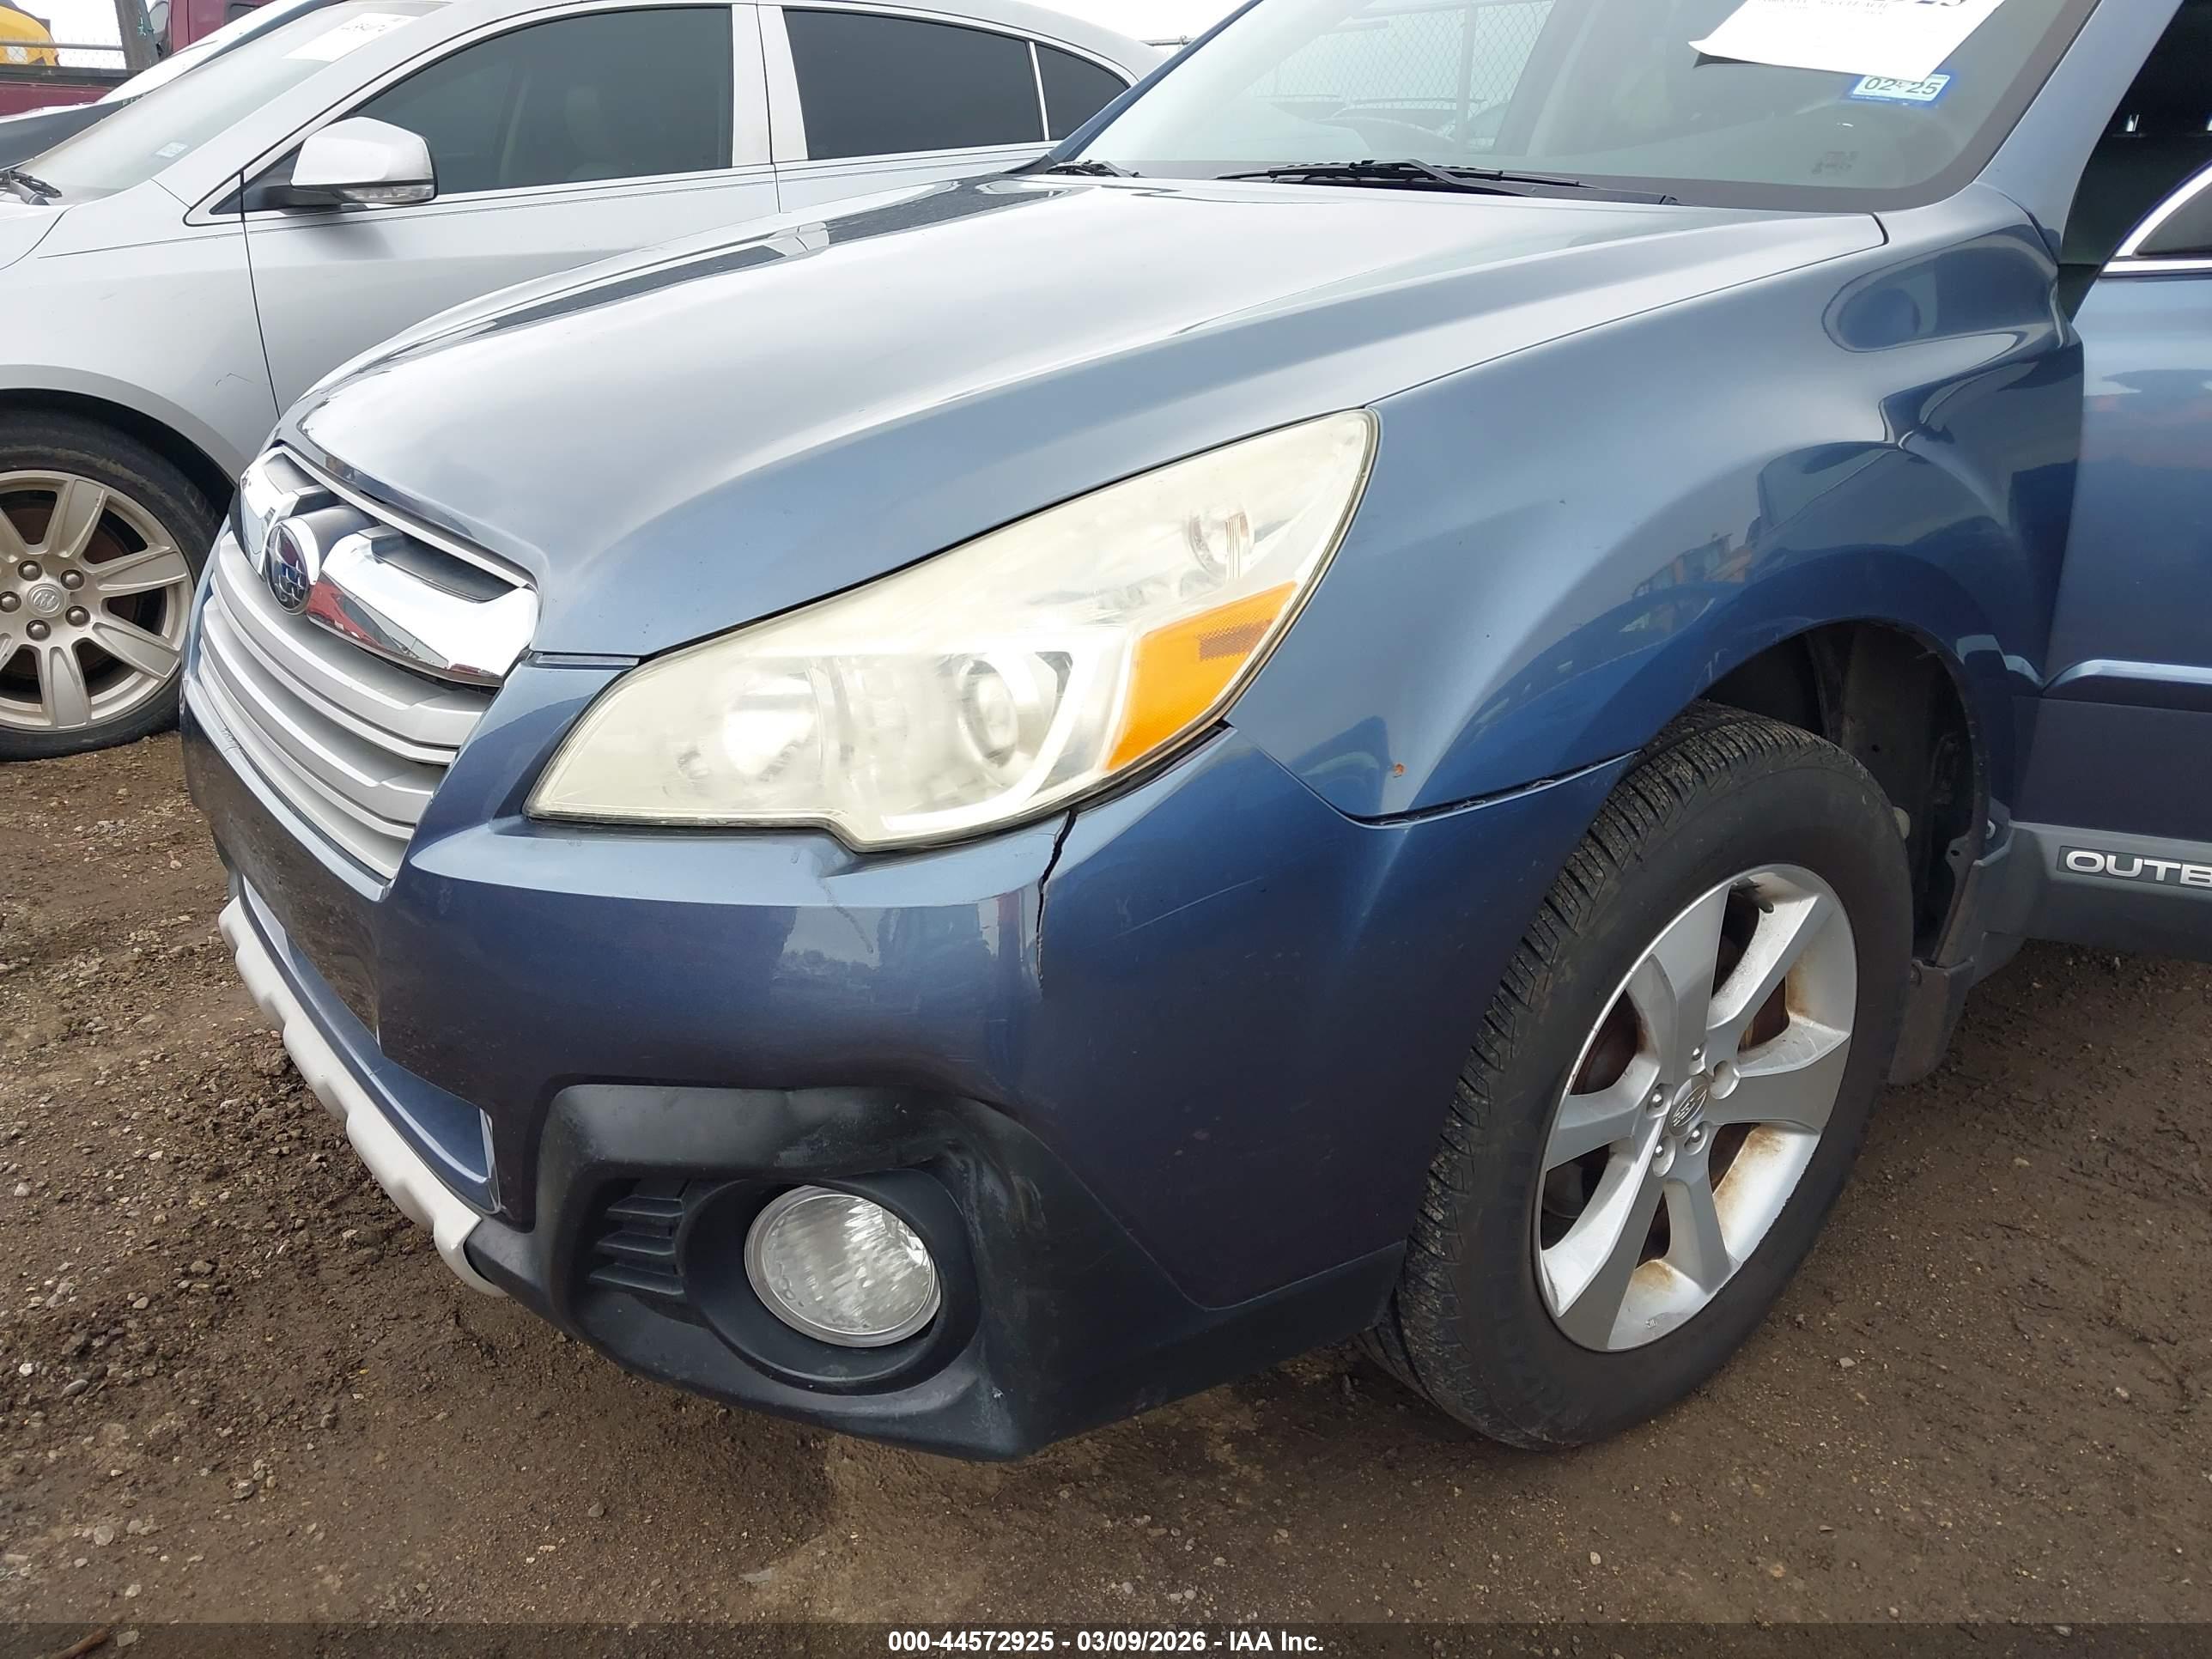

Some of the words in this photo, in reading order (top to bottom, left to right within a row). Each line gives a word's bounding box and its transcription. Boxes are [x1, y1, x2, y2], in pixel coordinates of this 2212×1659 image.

[1864, 77, 1897, 91] 02
[1905, 82, 1942, 94] 25
[2066, 850, 2212, 888] OUTB
